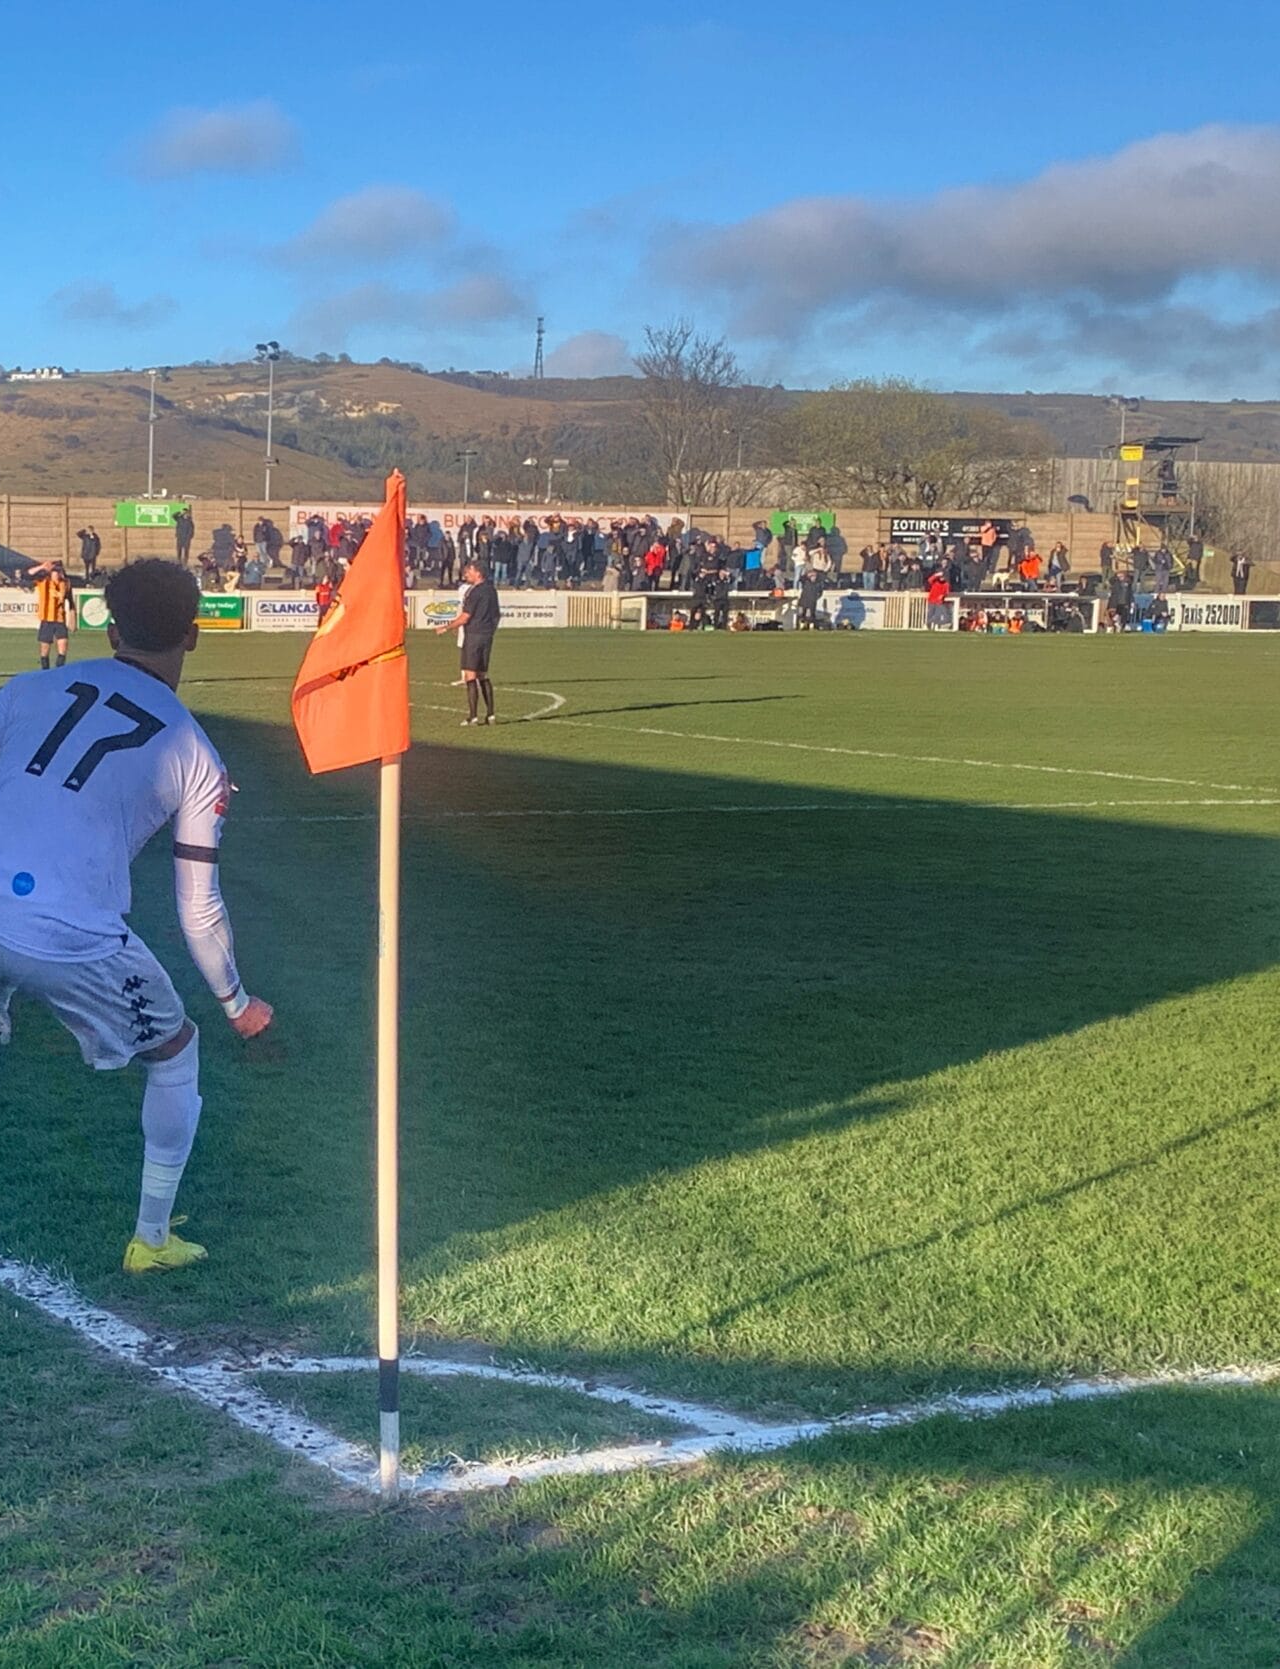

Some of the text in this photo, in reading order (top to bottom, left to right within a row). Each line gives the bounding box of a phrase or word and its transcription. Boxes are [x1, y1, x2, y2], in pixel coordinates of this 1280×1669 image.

[27, 603, 40, 613] LTD
[1181, 604, 1203, 625] Taxis
[1205, 604, 1241, 626] 252000
[24, 680, 167, 793] 17
